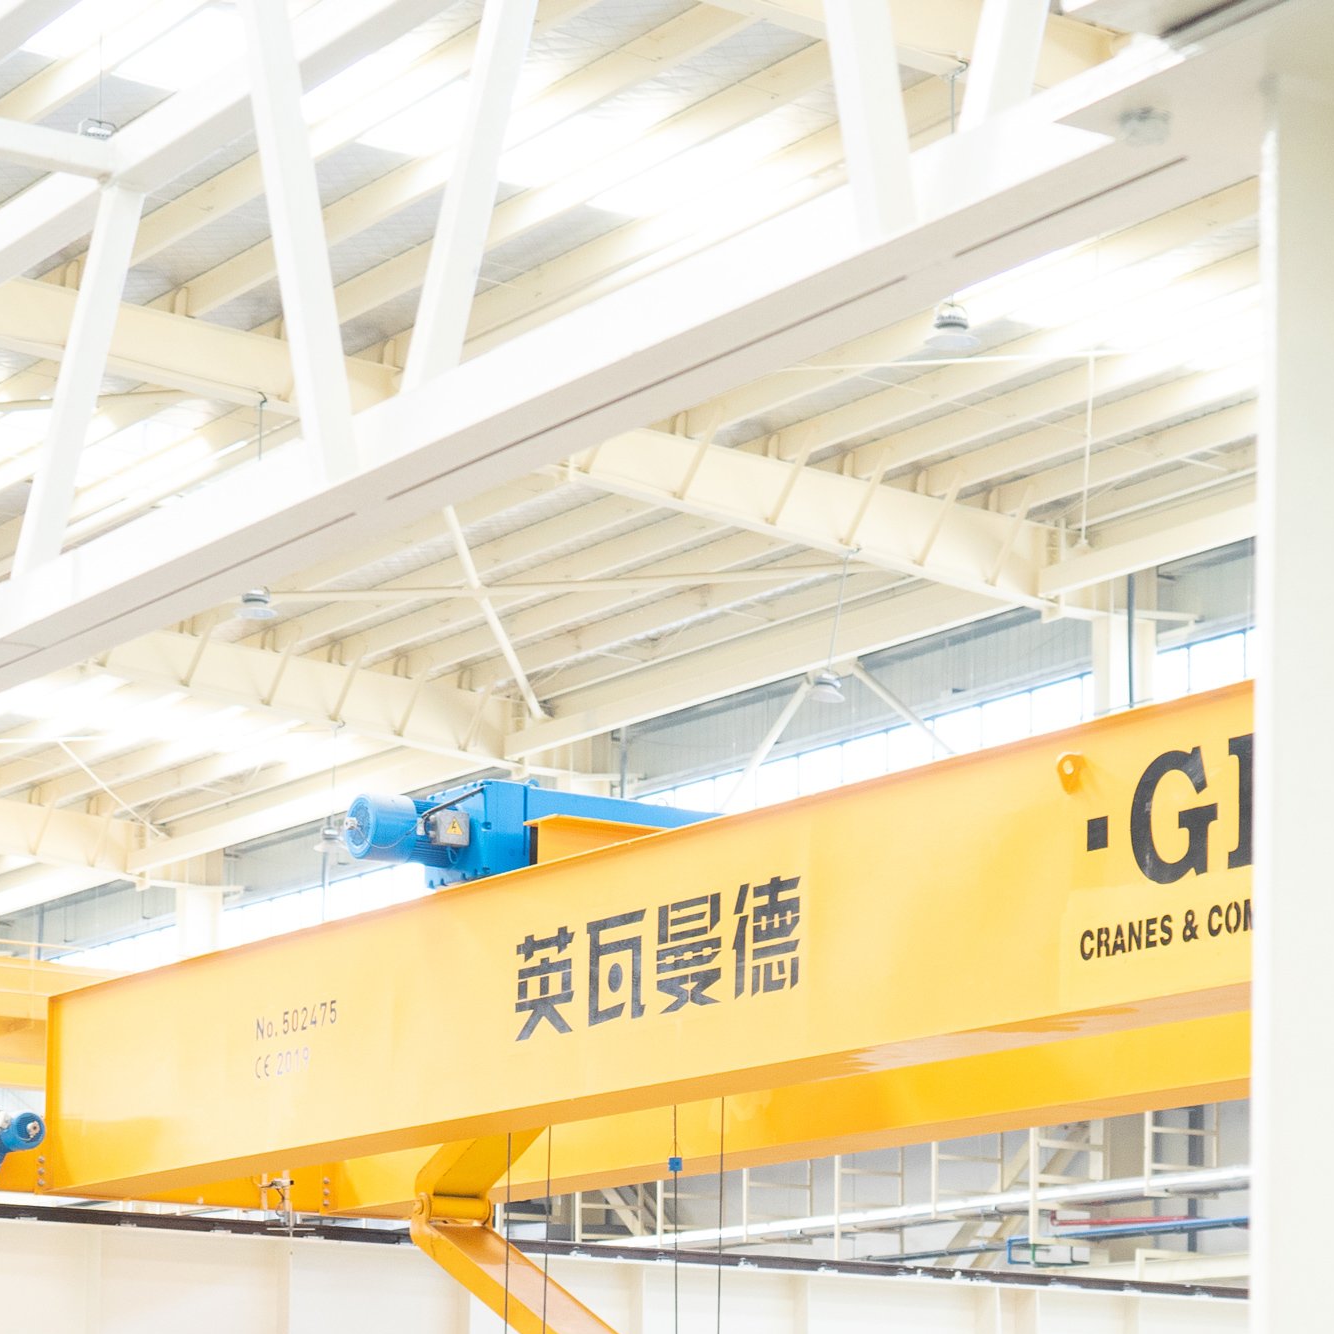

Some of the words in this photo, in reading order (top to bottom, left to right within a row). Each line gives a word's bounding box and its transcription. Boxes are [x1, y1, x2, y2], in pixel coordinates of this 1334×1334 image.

[515, 875, 801, 1041] 英瓦曼德
[1080, 914, 1173, 961] CRANES
[1182, 909, 1199, 943] &
[256, 1016, 278, 1041] No.
[282, 1000, 337, 1035] 502475
[276, 1046, 310, 1076] 2019
